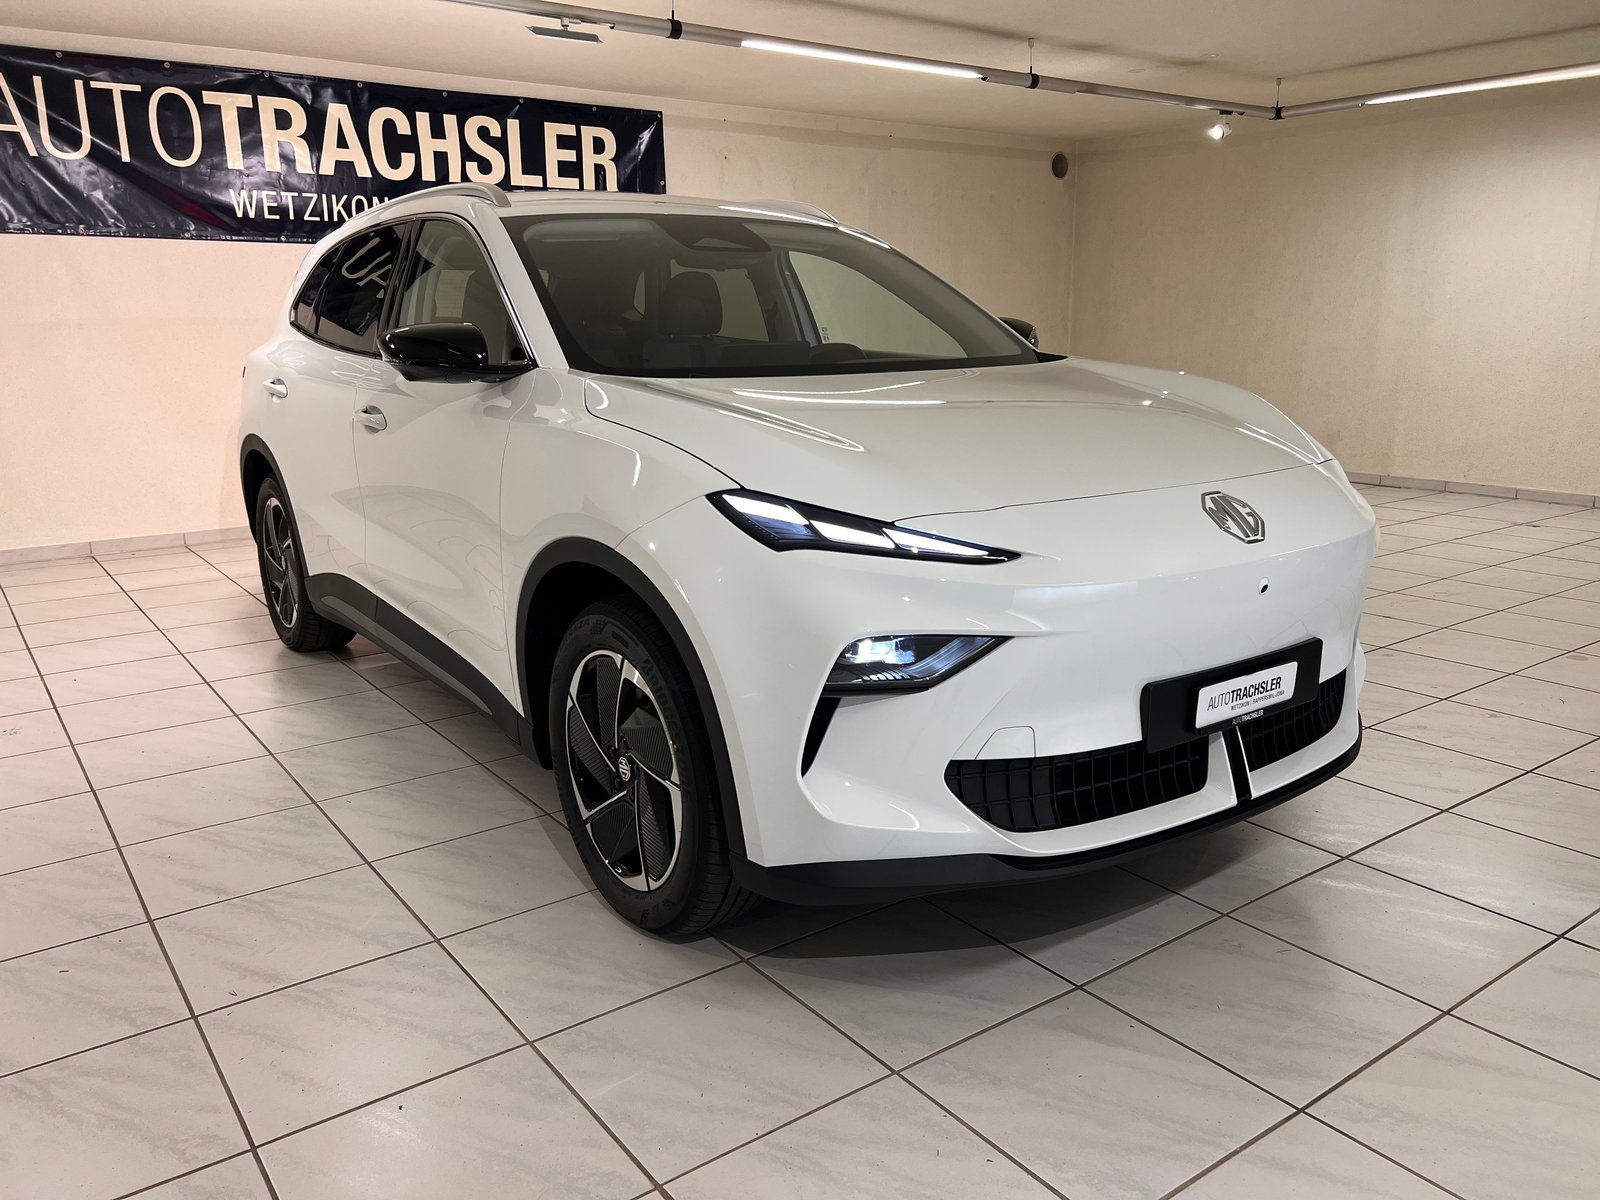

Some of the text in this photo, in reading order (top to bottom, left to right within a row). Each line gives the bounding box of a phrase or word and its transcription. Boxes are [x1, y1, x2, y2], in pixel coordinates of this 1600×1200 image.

[0, 72, 618, 192] AUTOTRACHSLER
[1206, 495, 1260, 539] MG
[1207, 676, 1282, 711] AUTOTRACHSLER
